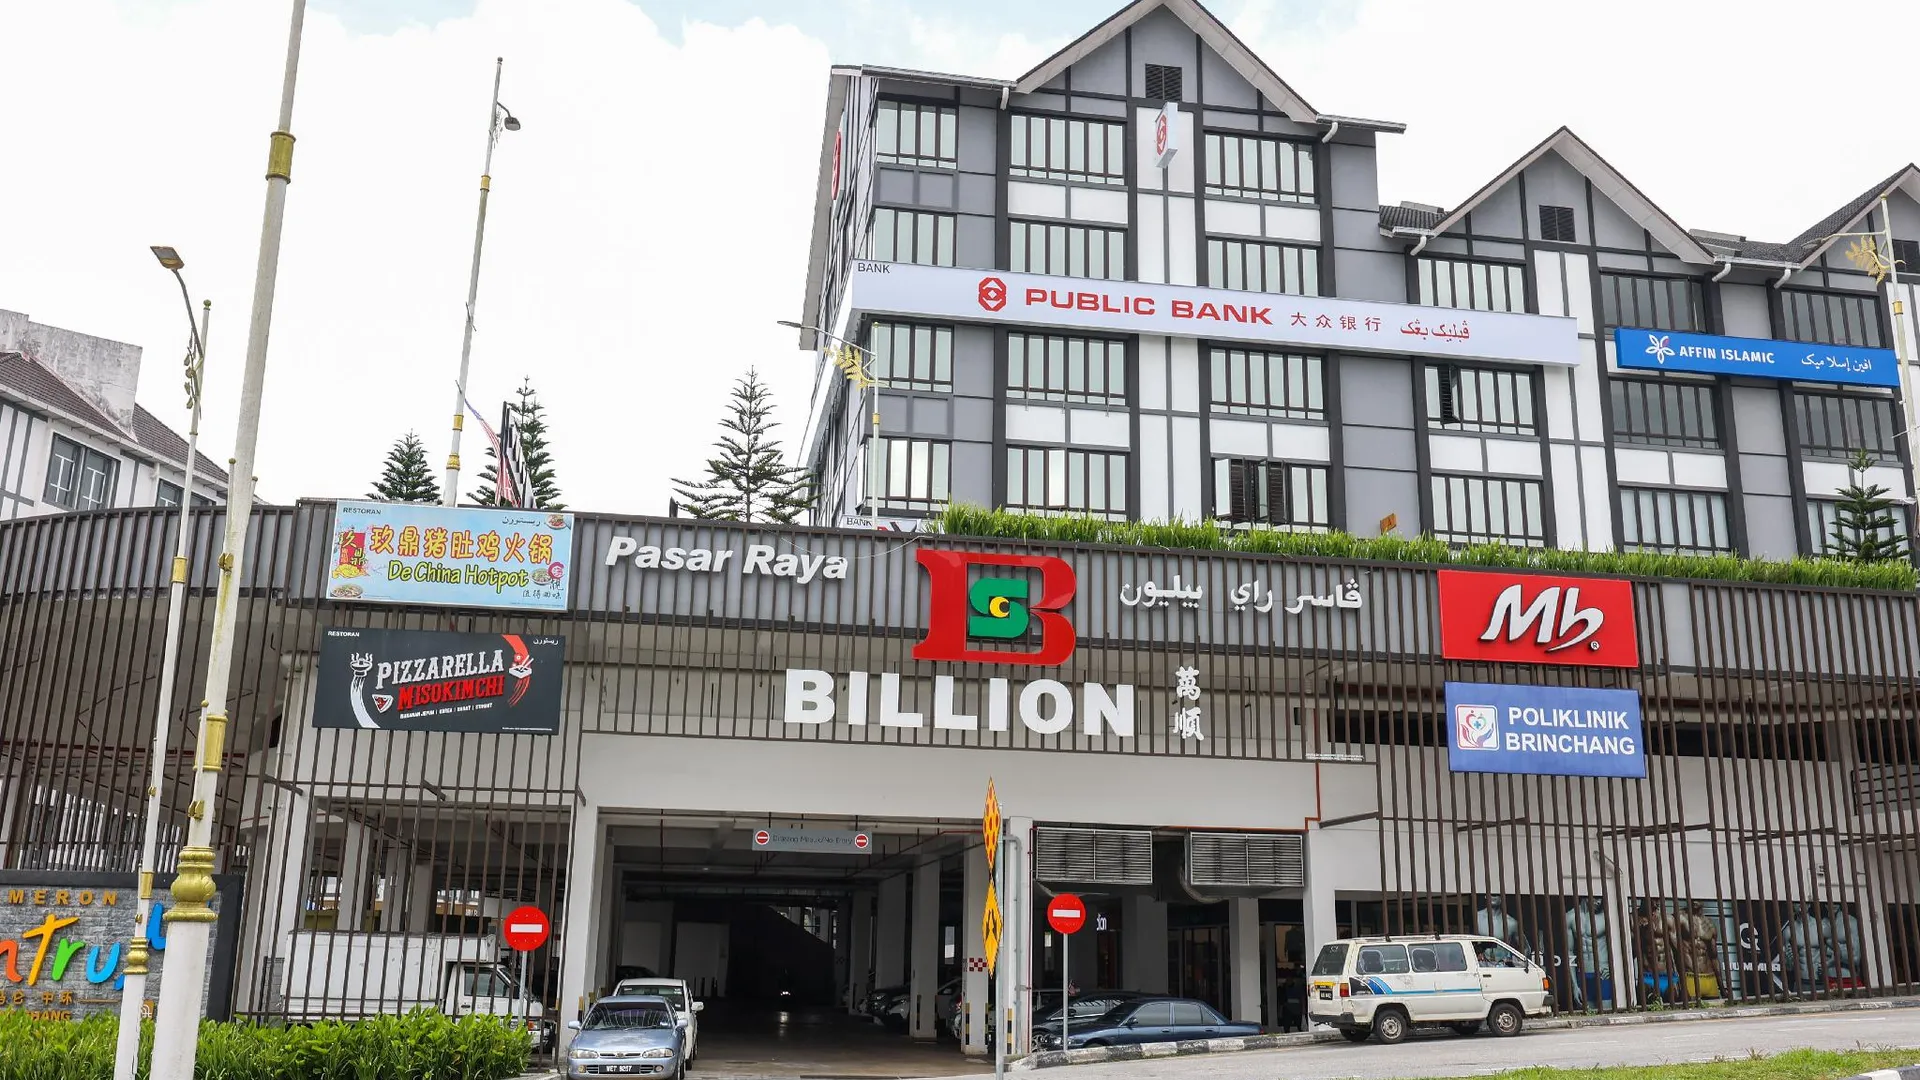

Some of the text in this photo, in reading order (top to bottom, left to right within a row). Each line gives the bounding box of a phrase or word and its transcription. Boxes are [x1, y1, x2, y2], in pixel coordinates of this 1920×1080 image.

[857, 262, 891, 274] BANK
[1025, 288, 1273, 326] PUBLIC BANK
[1290, 311, 1382, 332] 大众银行
[1679, 345, 1775, 364] AFFIN ISLAMIC
[342, 506, 382, 515] RESTORAN
[846, 517, 873, 527] BANK
[369, 524, 553, 565] 玖鼎猪肚鸡火锅
[605, 535, 848, 584] Pasar Raya
[387, 559, 412, 582] De
[413, 560, 461, 585] China
[464, 564, 530, 595] Hotpot
[1230, 579, 1273, 613] راي
[1480, 583, 1605, 653] Mb
[375, 649, 504, 690] PIZZARELLA
[397, 673, 505, 712] MISOKIMCHI
[784, 668, 1134, 737] BILLION
[1508, 706, 1630, 730] POLIKLINIK
[1504, 732, 1636, 756] BRINCHANG
